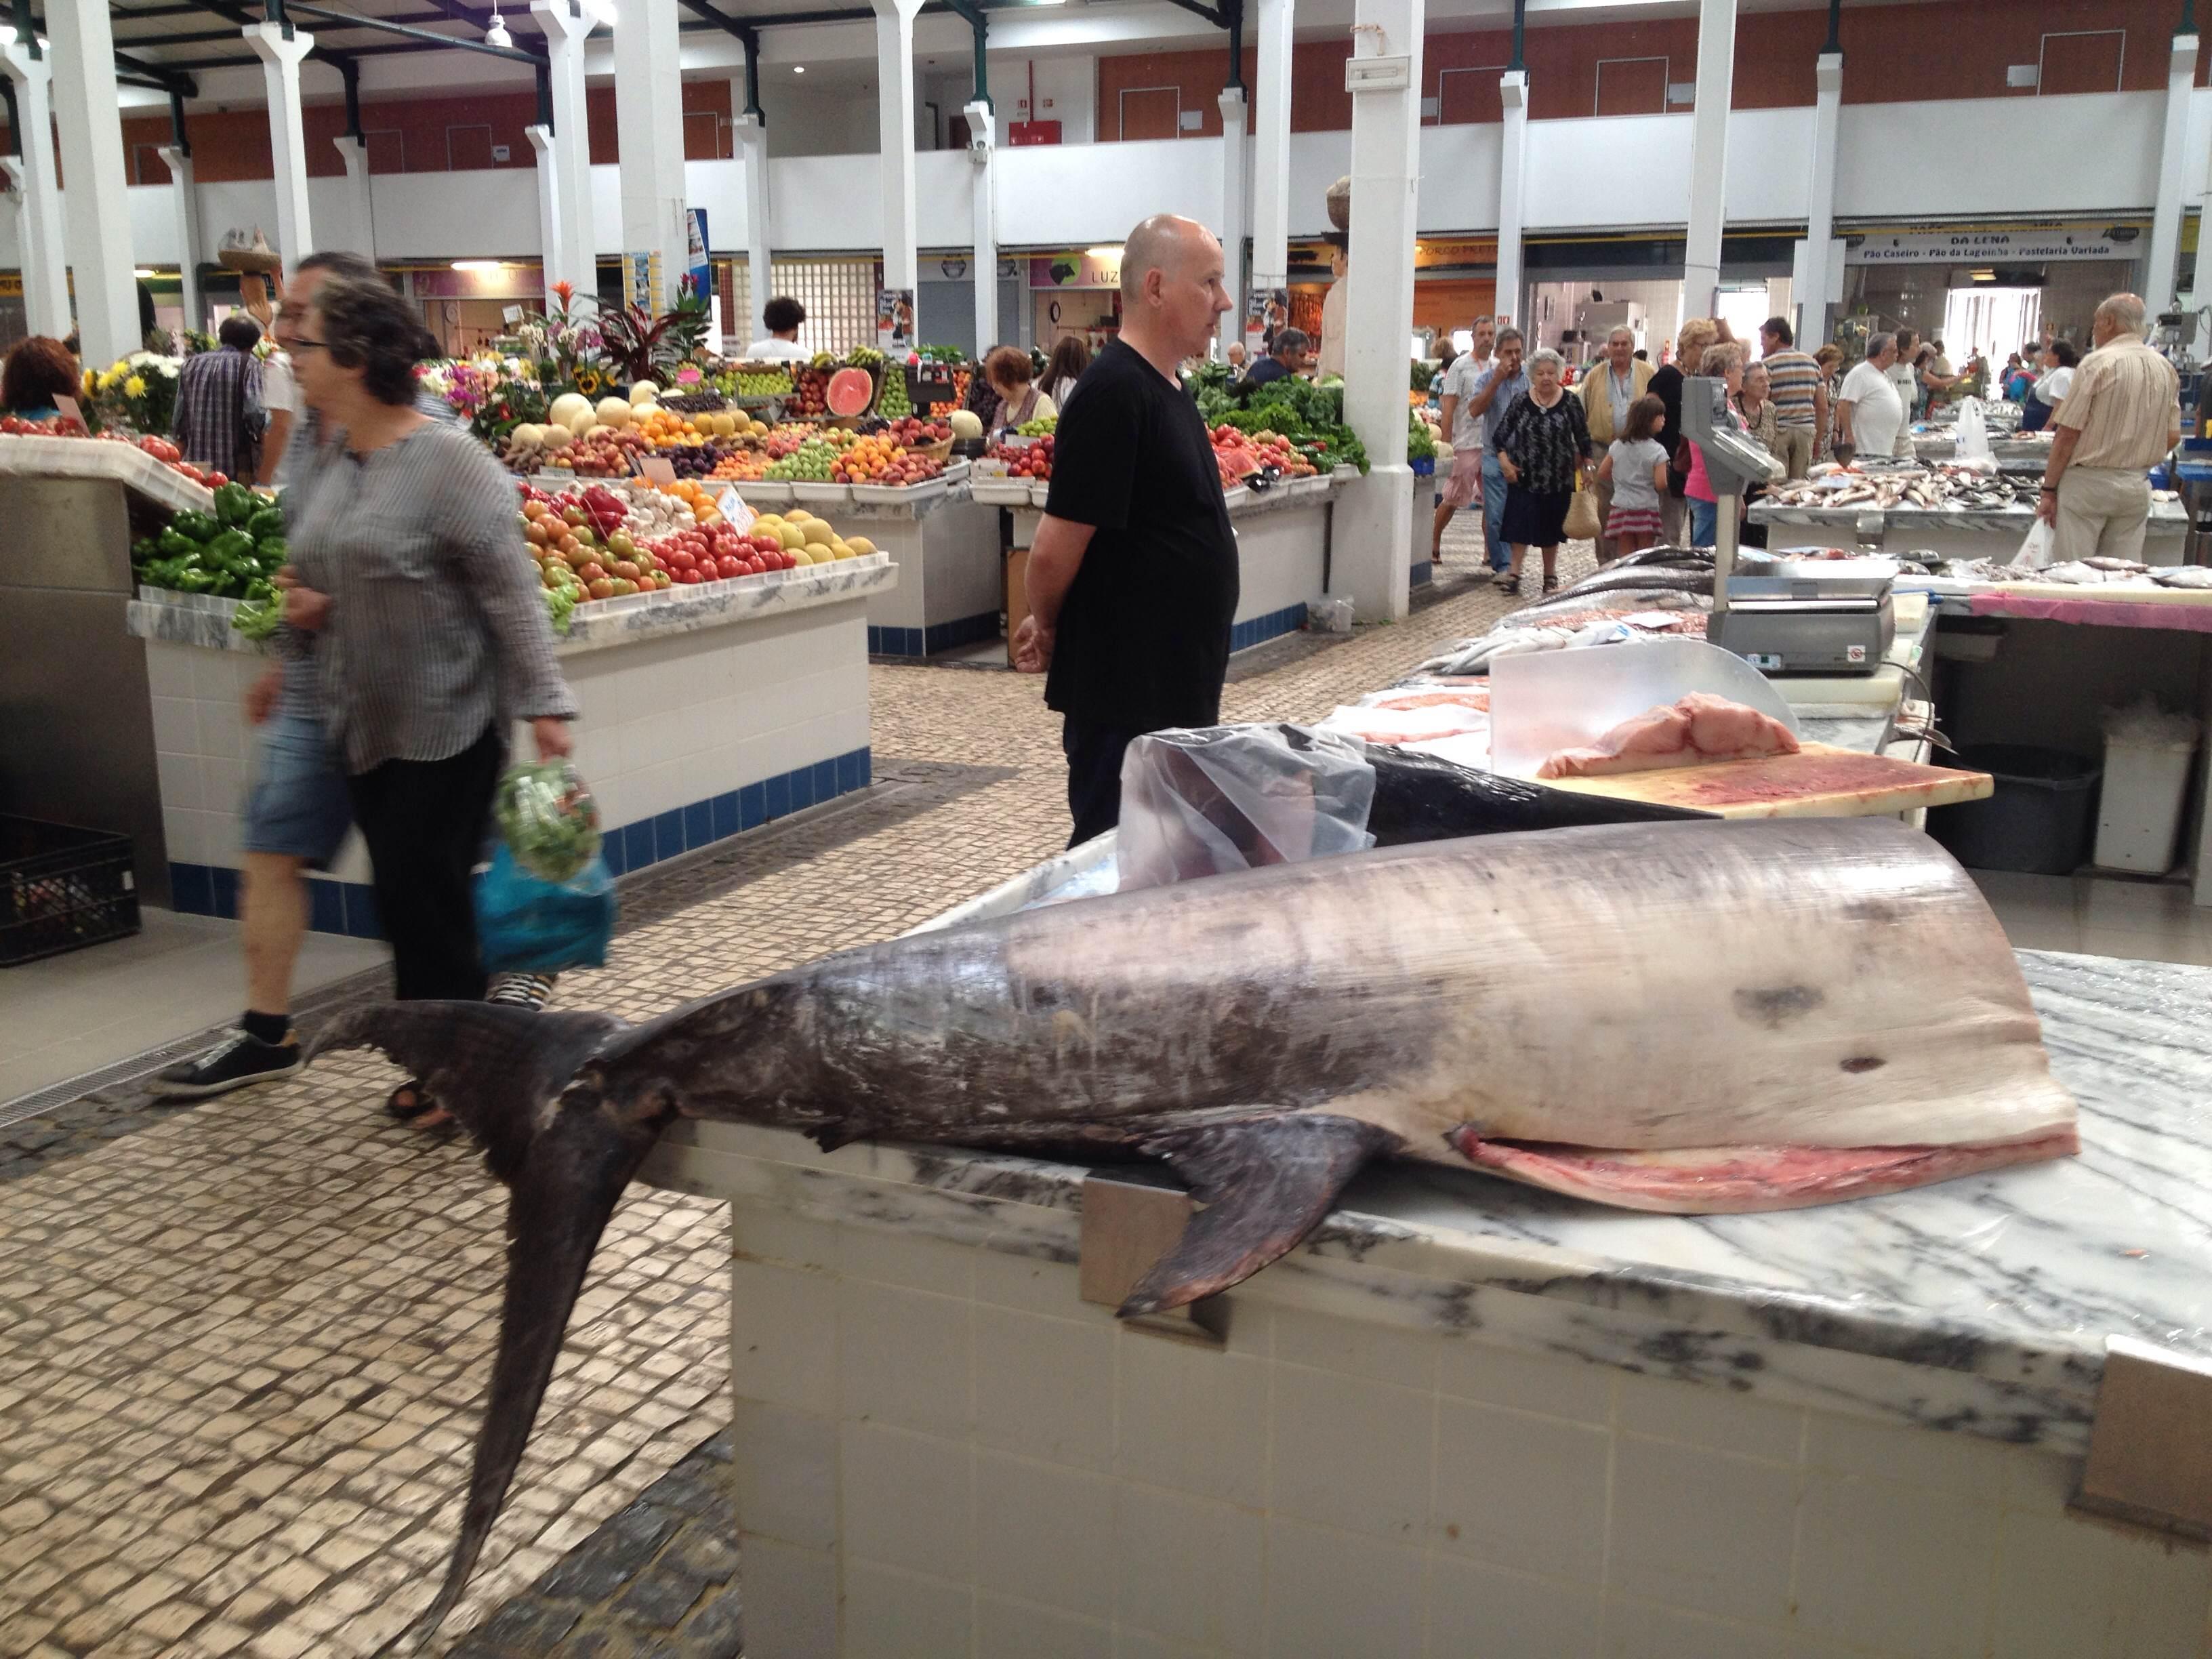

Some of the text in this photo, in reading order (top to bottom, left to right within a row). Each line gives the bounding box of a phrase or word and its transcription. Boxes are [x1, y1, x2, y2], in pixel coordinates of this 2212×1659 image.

[1974, 235, 2010, 244] LENA
[1864, 250, 1881, 259] Pão
[1884, 249, 1919, 258] Caseiro
[1929, 249, 1946, 258] Pão
[1949, 249, 1961, 257] da
[2019, 245, 2068, 256] Pastelaria
[2071, 245, 2110, 255] Variada
